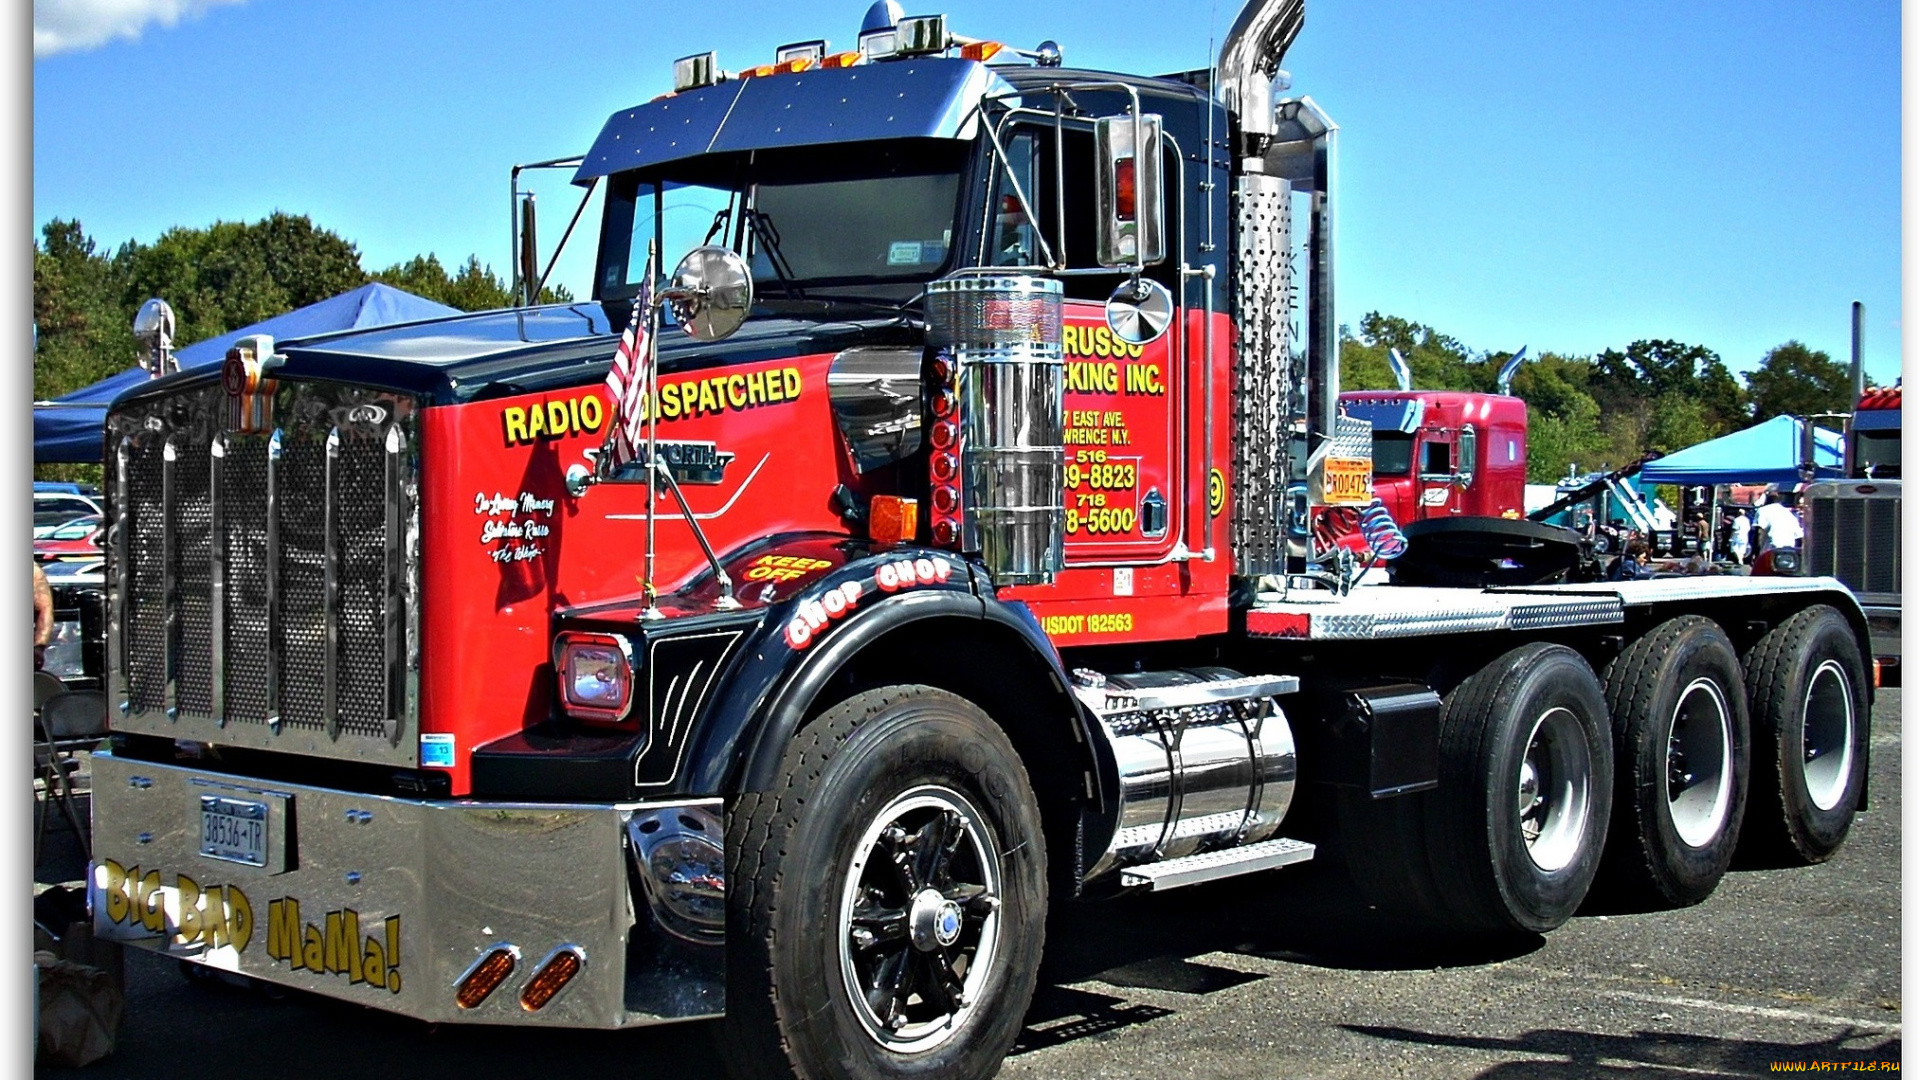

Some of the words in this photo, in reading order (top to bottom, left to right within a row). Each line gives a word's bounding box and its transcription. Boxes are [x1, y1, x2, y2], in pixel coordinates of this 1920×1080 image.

[1126, 364, 1165, 394] INC.
[505, 394, 603, 442] RADIO
[1073, 411, 1100, 427] EAST
[1103, 411, 1126, 428] AVE.
[1111, 429, 1131, 445] N.Y.
[1076, 449, 1108, 463] 516
[1075, 493, 1107, 507] 718
[1064, 508, 1134, 533] 8-5600
[754, 555, 833, 570] KEEP
[877, 557, 952, 590] CHOP
[748, 566, 807, 582] OFF
[785, 580, 863, 647] CHOP
[1042, 614, 1085, 635] USDOT
[1086, 613, 1133, 633] 182563
[105, 857, 166, 933] BIG
[177, 872, 254, 955] BAD
[266, 896, 402, 995] MaMa!
